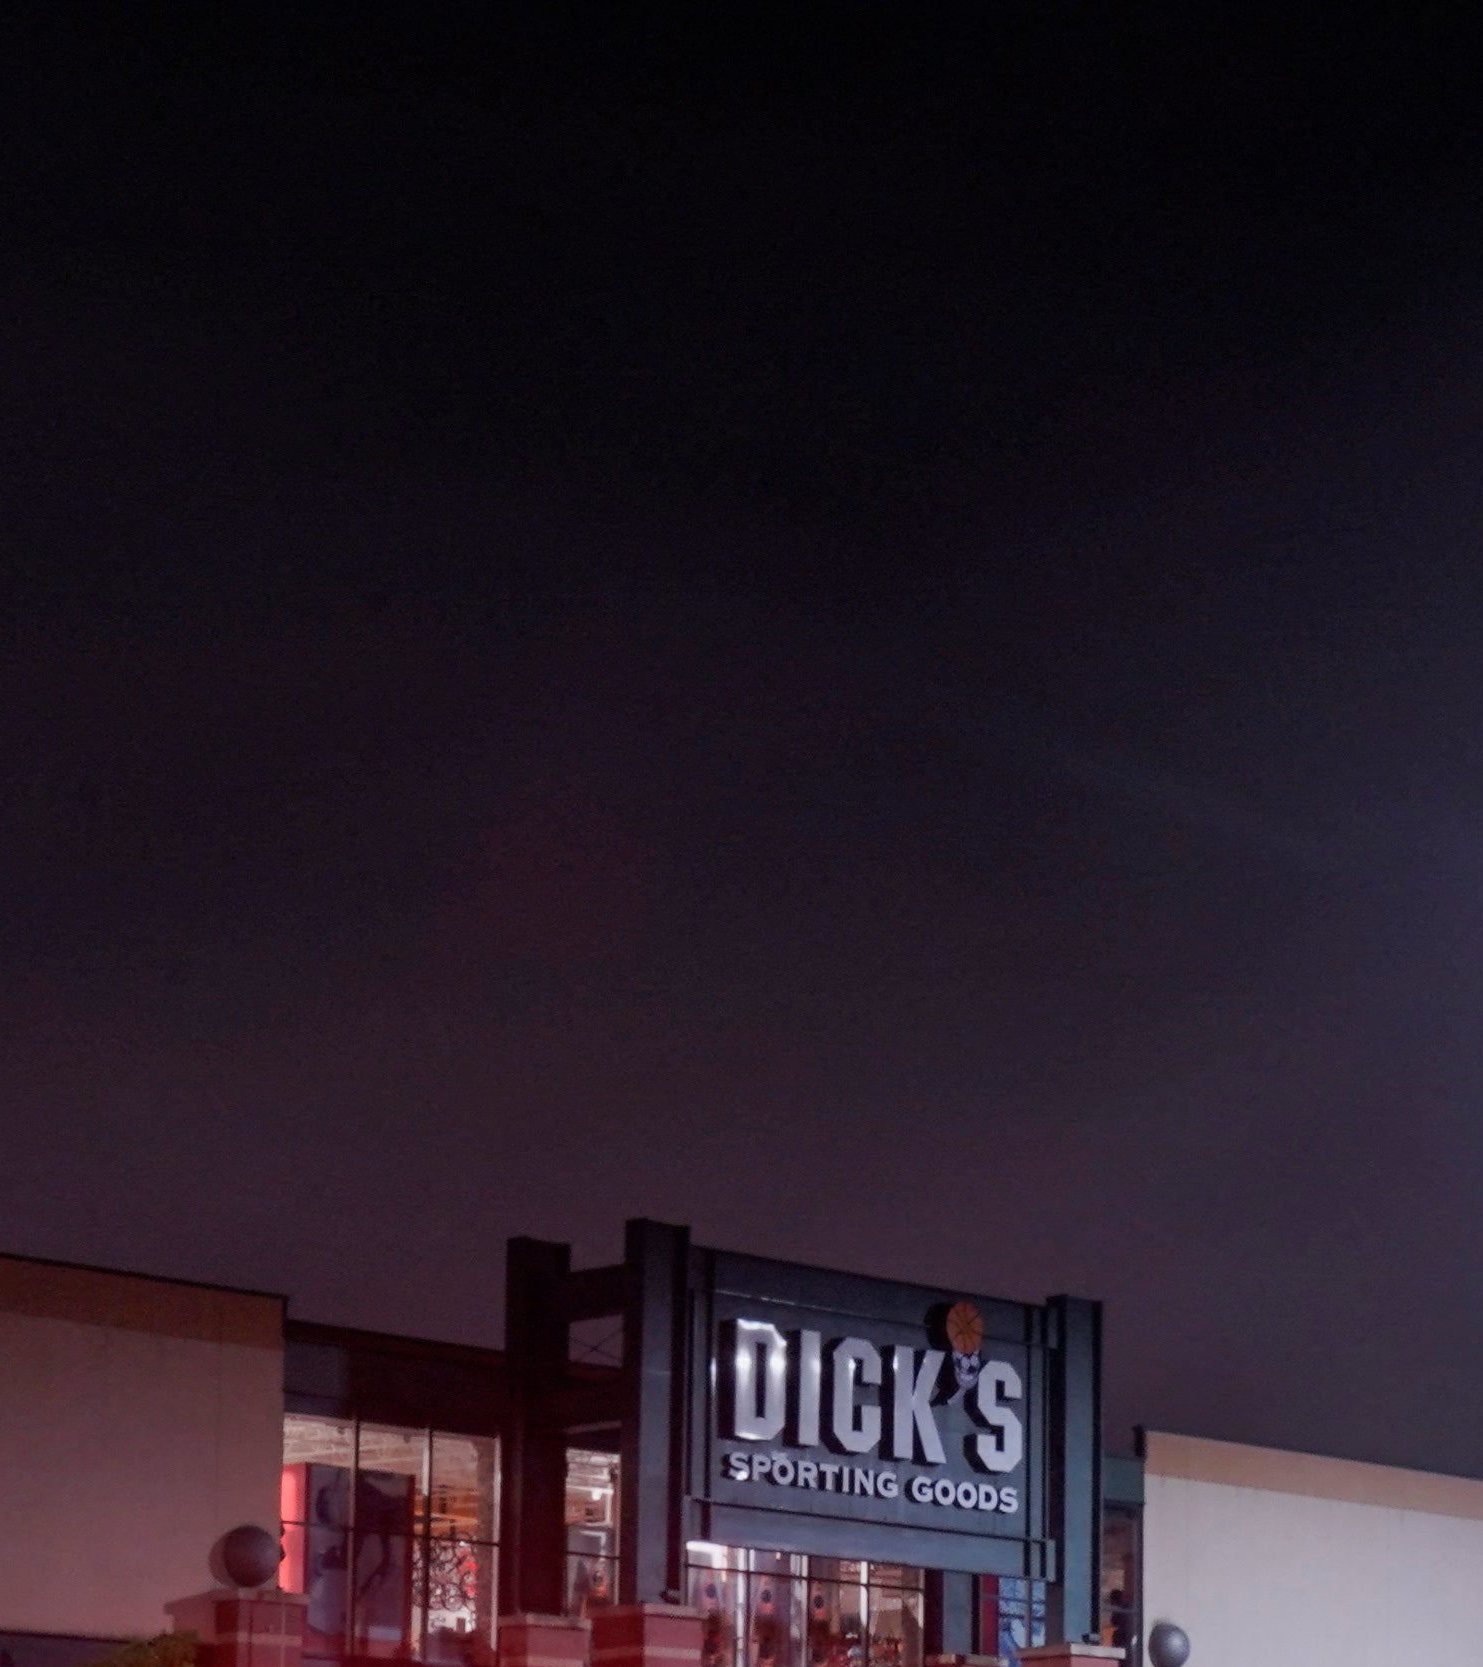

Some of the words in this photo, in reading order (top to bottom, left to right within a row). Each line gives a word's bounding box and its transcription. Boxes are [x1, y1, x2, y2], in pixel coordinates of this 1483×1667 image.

[728, 1303, 1023, 1473] DICK'S
[726, 1451, 898, 1499] SPORTING
[910, 1476, 1018, 1514] GOODS
